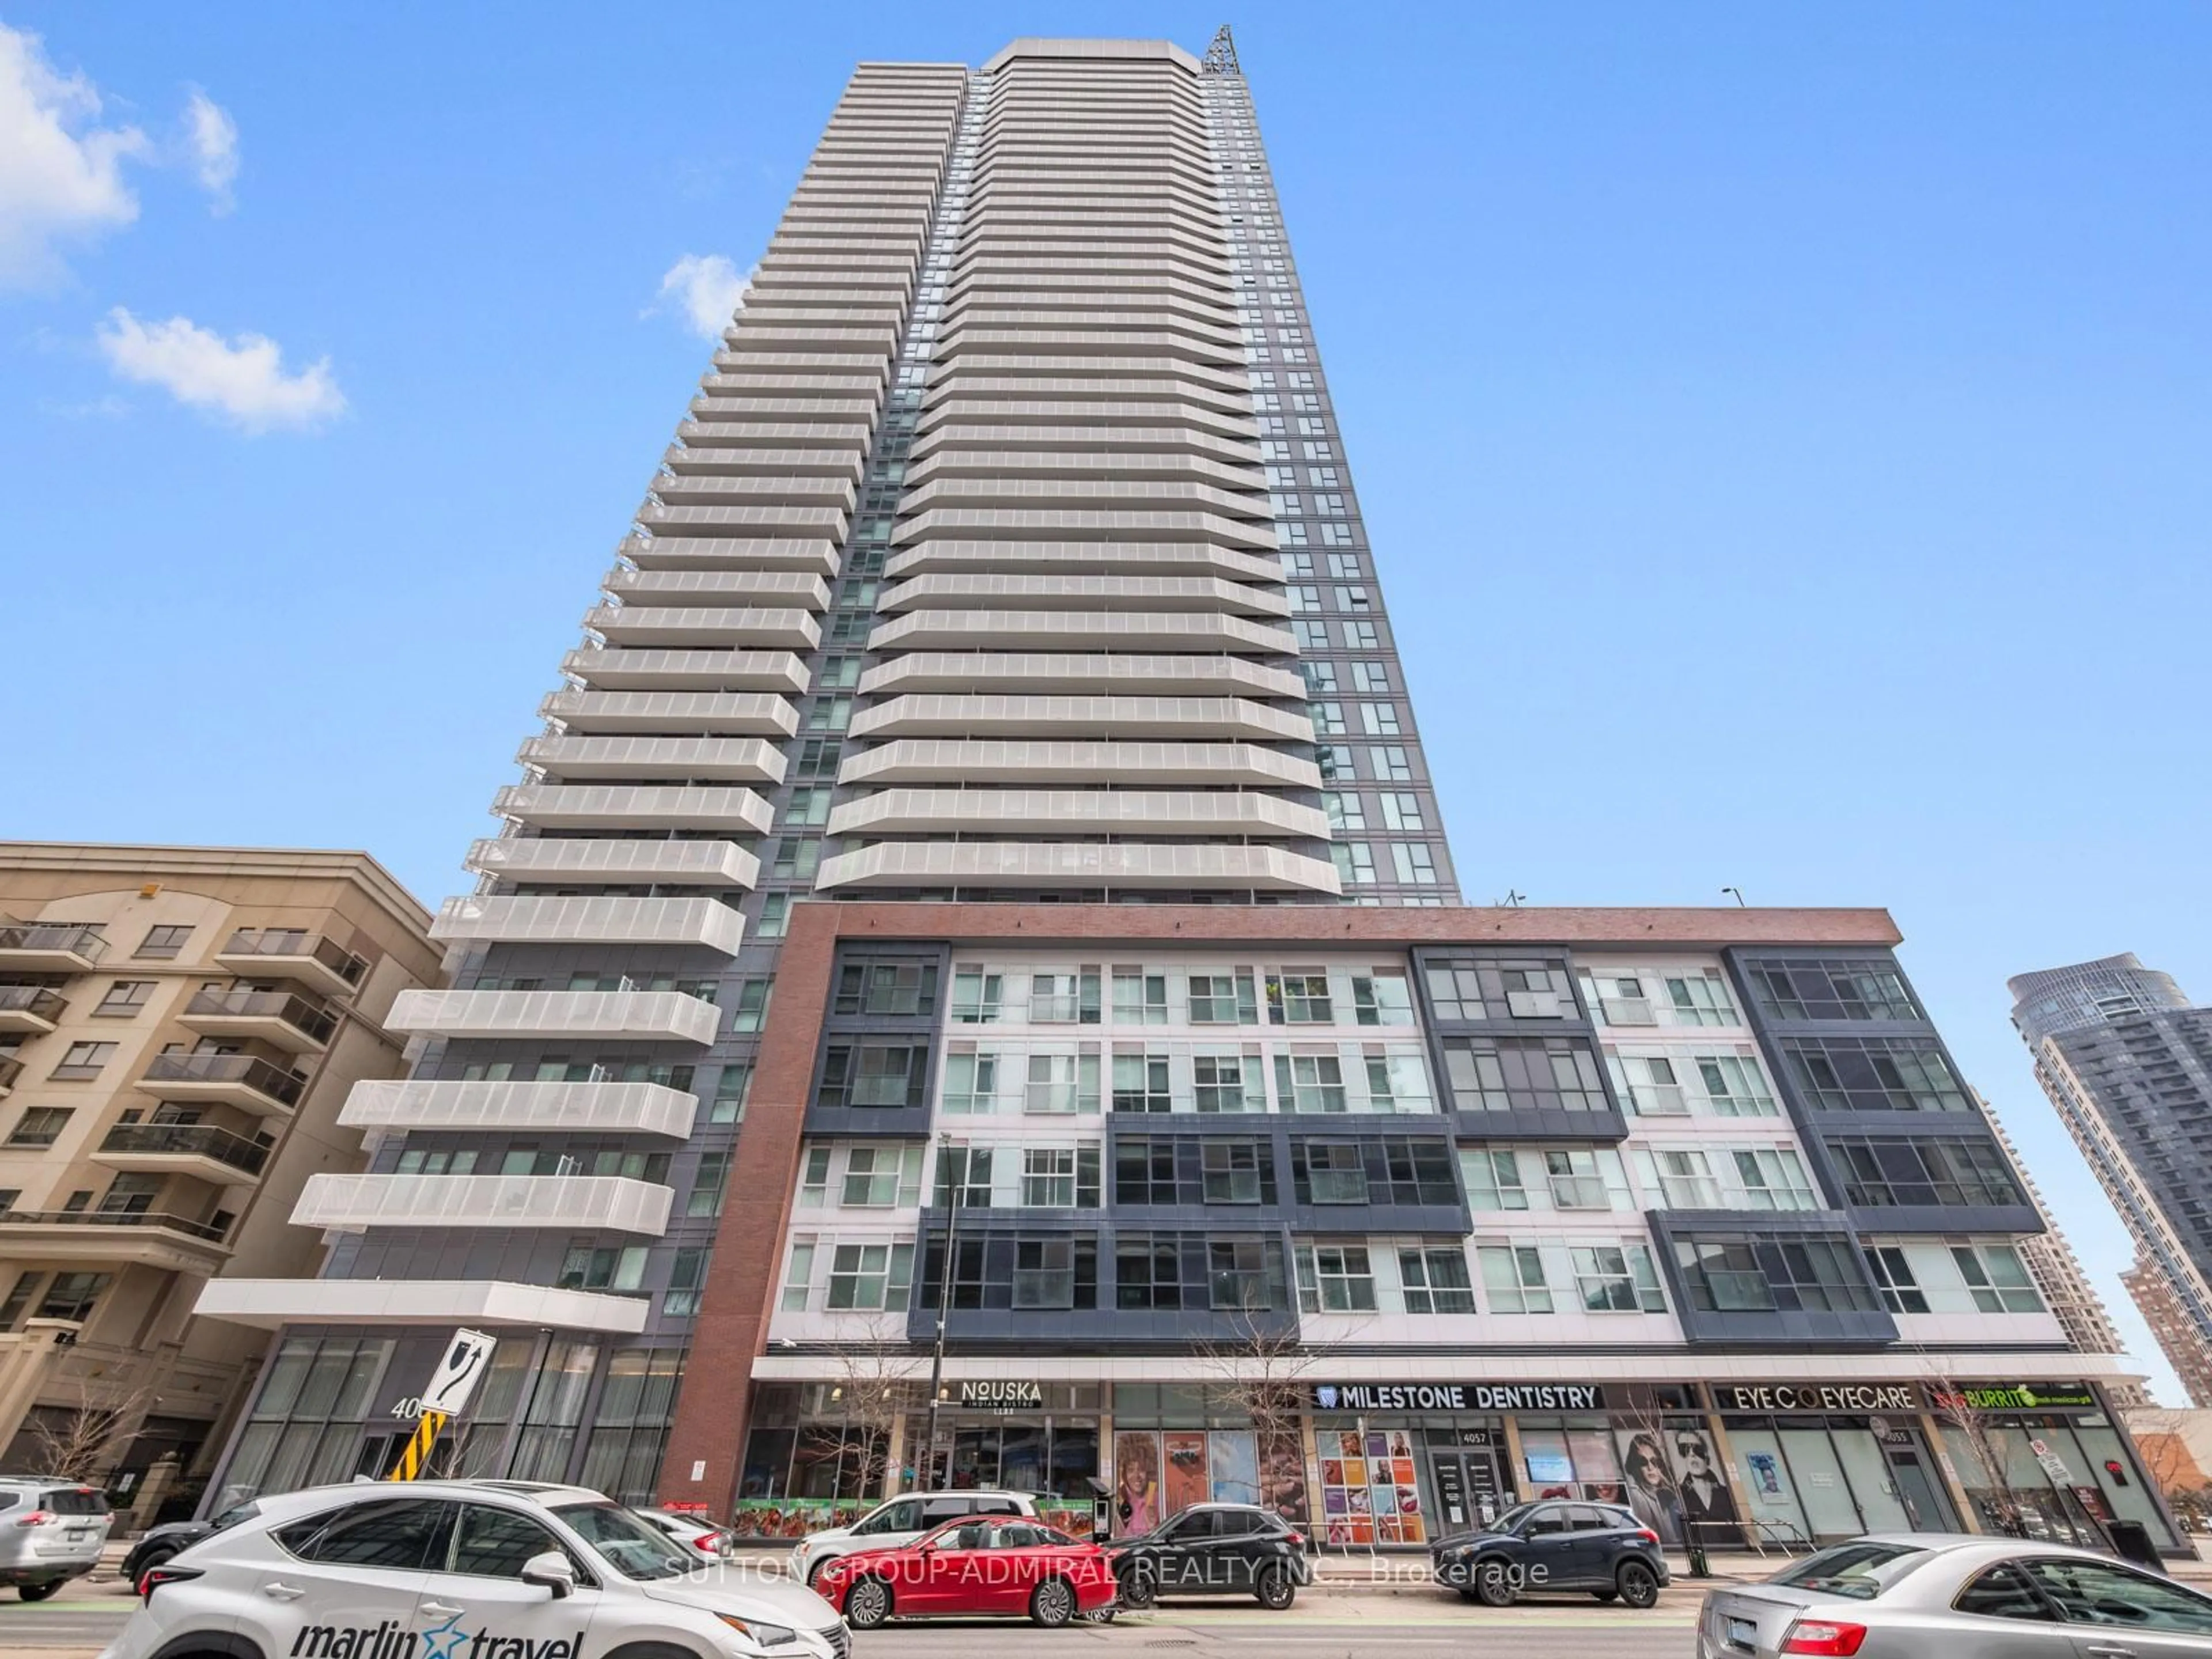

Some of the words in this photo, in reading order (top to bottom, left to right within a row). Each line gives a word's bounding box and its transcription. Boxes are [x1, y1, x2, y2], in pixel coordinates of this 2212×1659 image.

[962, 1382, 1041, 1400] NOUSKA
[1343, 1386, 1465, 1408] MILESTONE
[1477, 1386, 1595, 1408] DENTISTRY
[1734, 1387, 1774, 1409] EYE
[1820, 1387, 1916, 1409] EYECARE
[1464, 1433, 1486, 1443] 4057
[290, 1620, 418, 1659] marlin
[471, 1627, 584, 1659] travel
